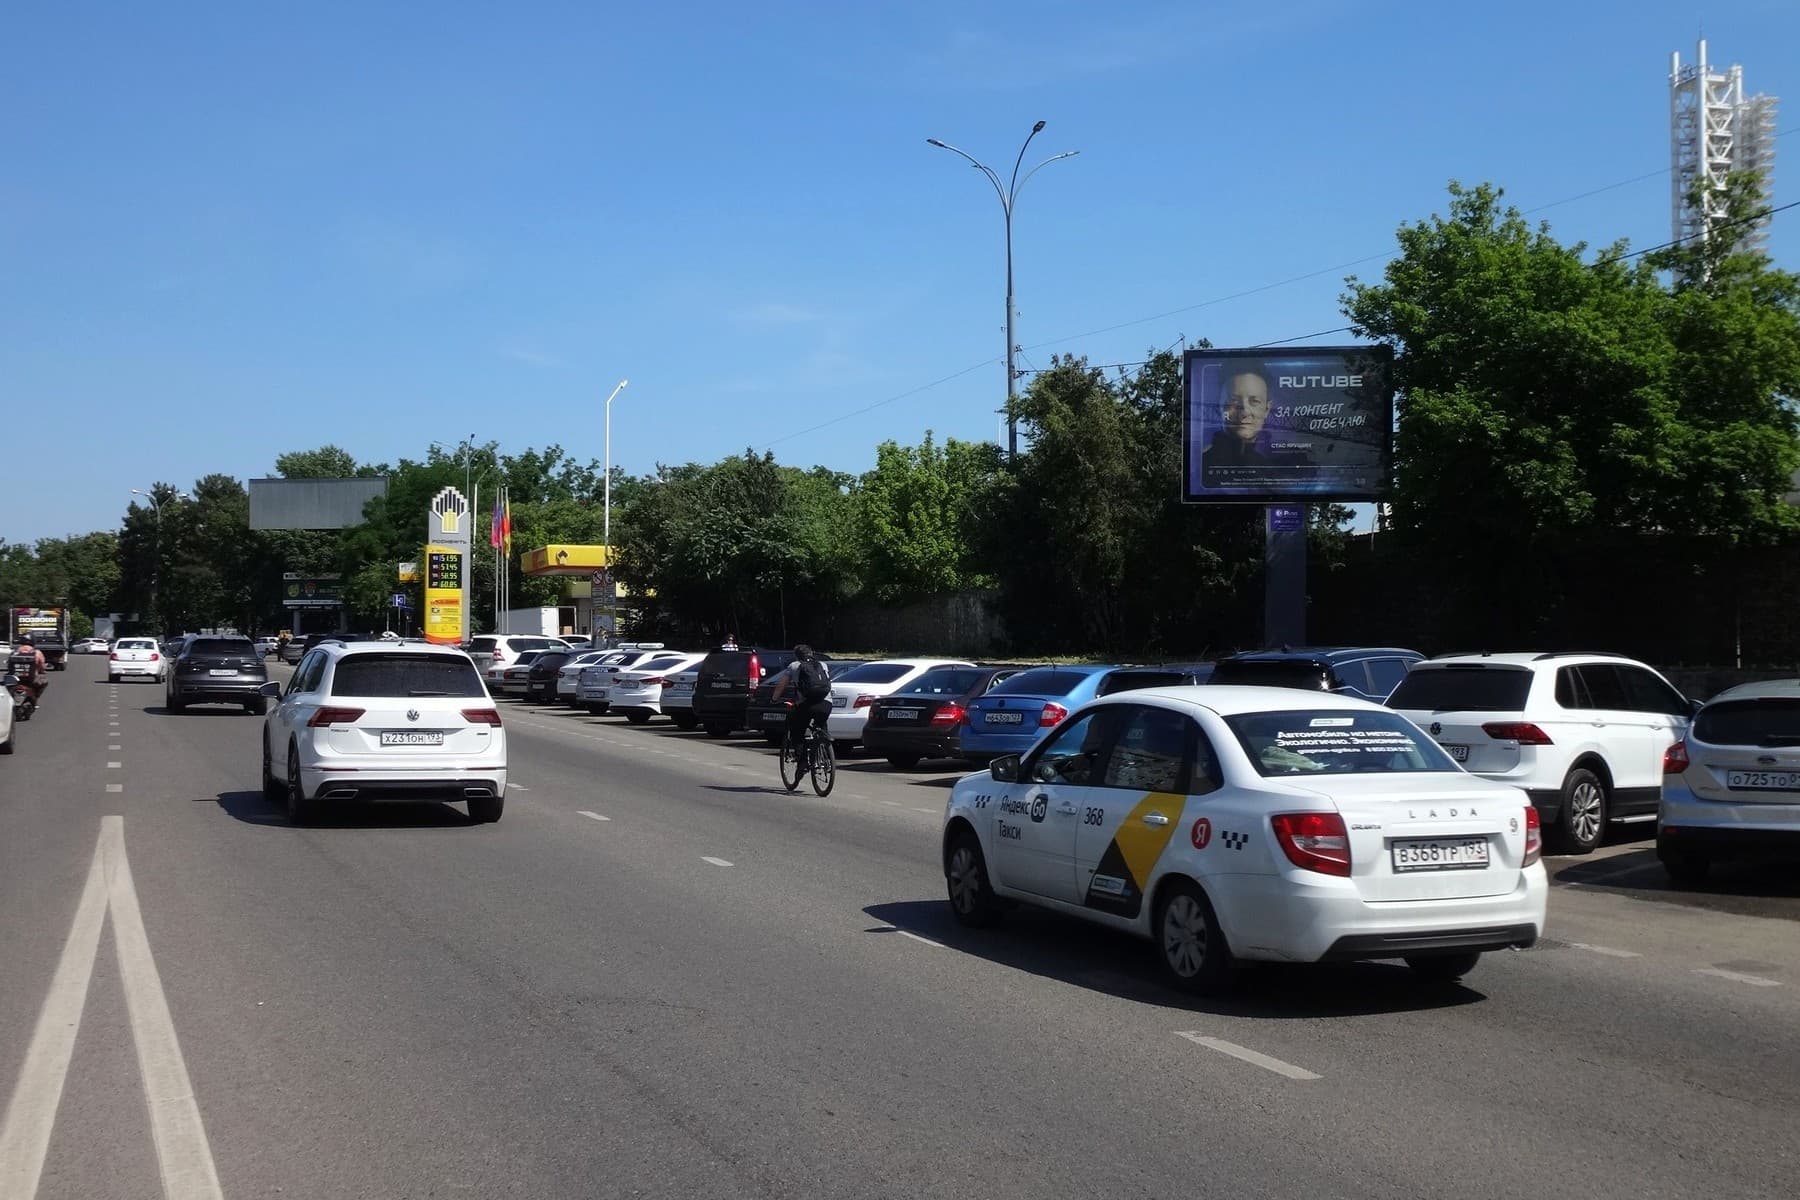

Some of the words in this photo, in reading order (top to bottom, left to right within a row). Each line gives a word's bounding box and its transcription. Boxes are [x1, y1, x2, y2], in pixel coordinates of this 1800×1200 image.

[1279, 375, 1363, 388] RUTUBE
[1275, 405, 1290, 418] ЗА
[1293, 402, 1344, 417] КОНТЕНТ
[1309, 415, 1367, 431] ОТВЕЧАЮ!
[1450, 747, 1465, 756] 193
[1000, 795, 1031, 817] Яндекс
[1032, 798, 1046, 818] Go
[1409, 807, 1478, 820] LADA
[1084, 806, 1105, 827] 368
[998, 819, 1022, 841] Такси
[1400, 843, 1458, 863] В368ТР
[1463, 841, 1484, 856] 193
